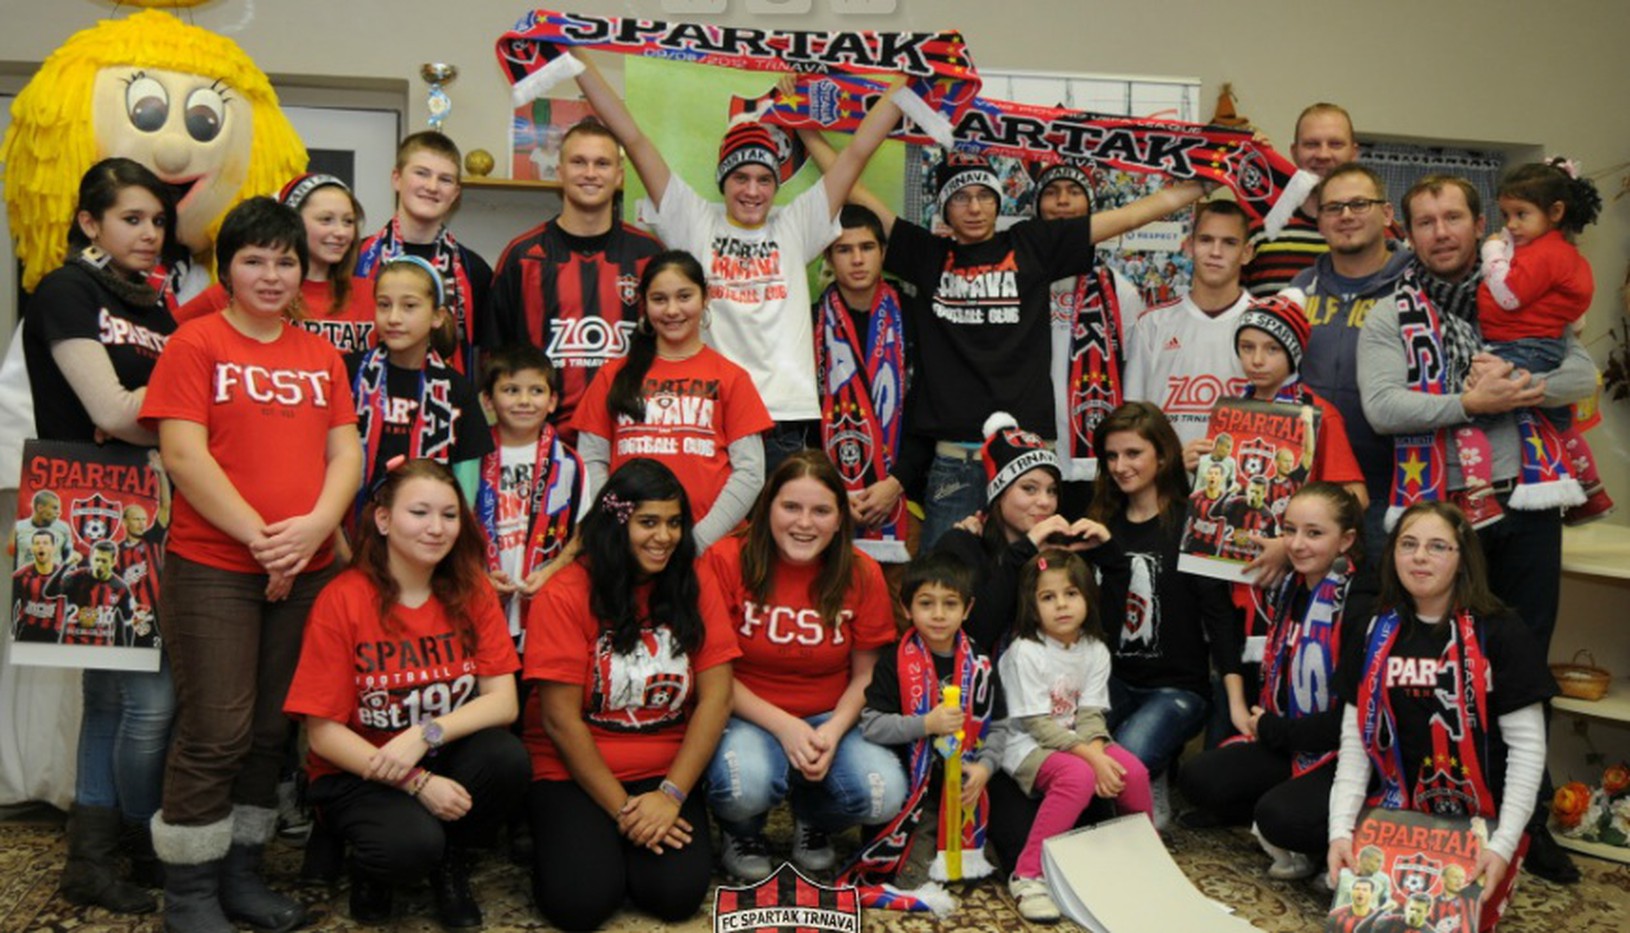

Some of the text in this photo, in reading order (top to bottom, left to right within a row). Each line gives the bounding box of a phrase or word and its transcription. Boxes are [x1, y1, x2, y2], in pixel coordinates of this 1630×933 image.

[561, 12, 934, 77] SPARTAK
[756, 60, 829, 74] TRNAVA
[943, 170, 991, 195] TRNAVA
[545, 315, 638, 359] ZOS
[215, 362, 330, 407] FCST
[1464, 645, 1478, 729] LEAGUE
